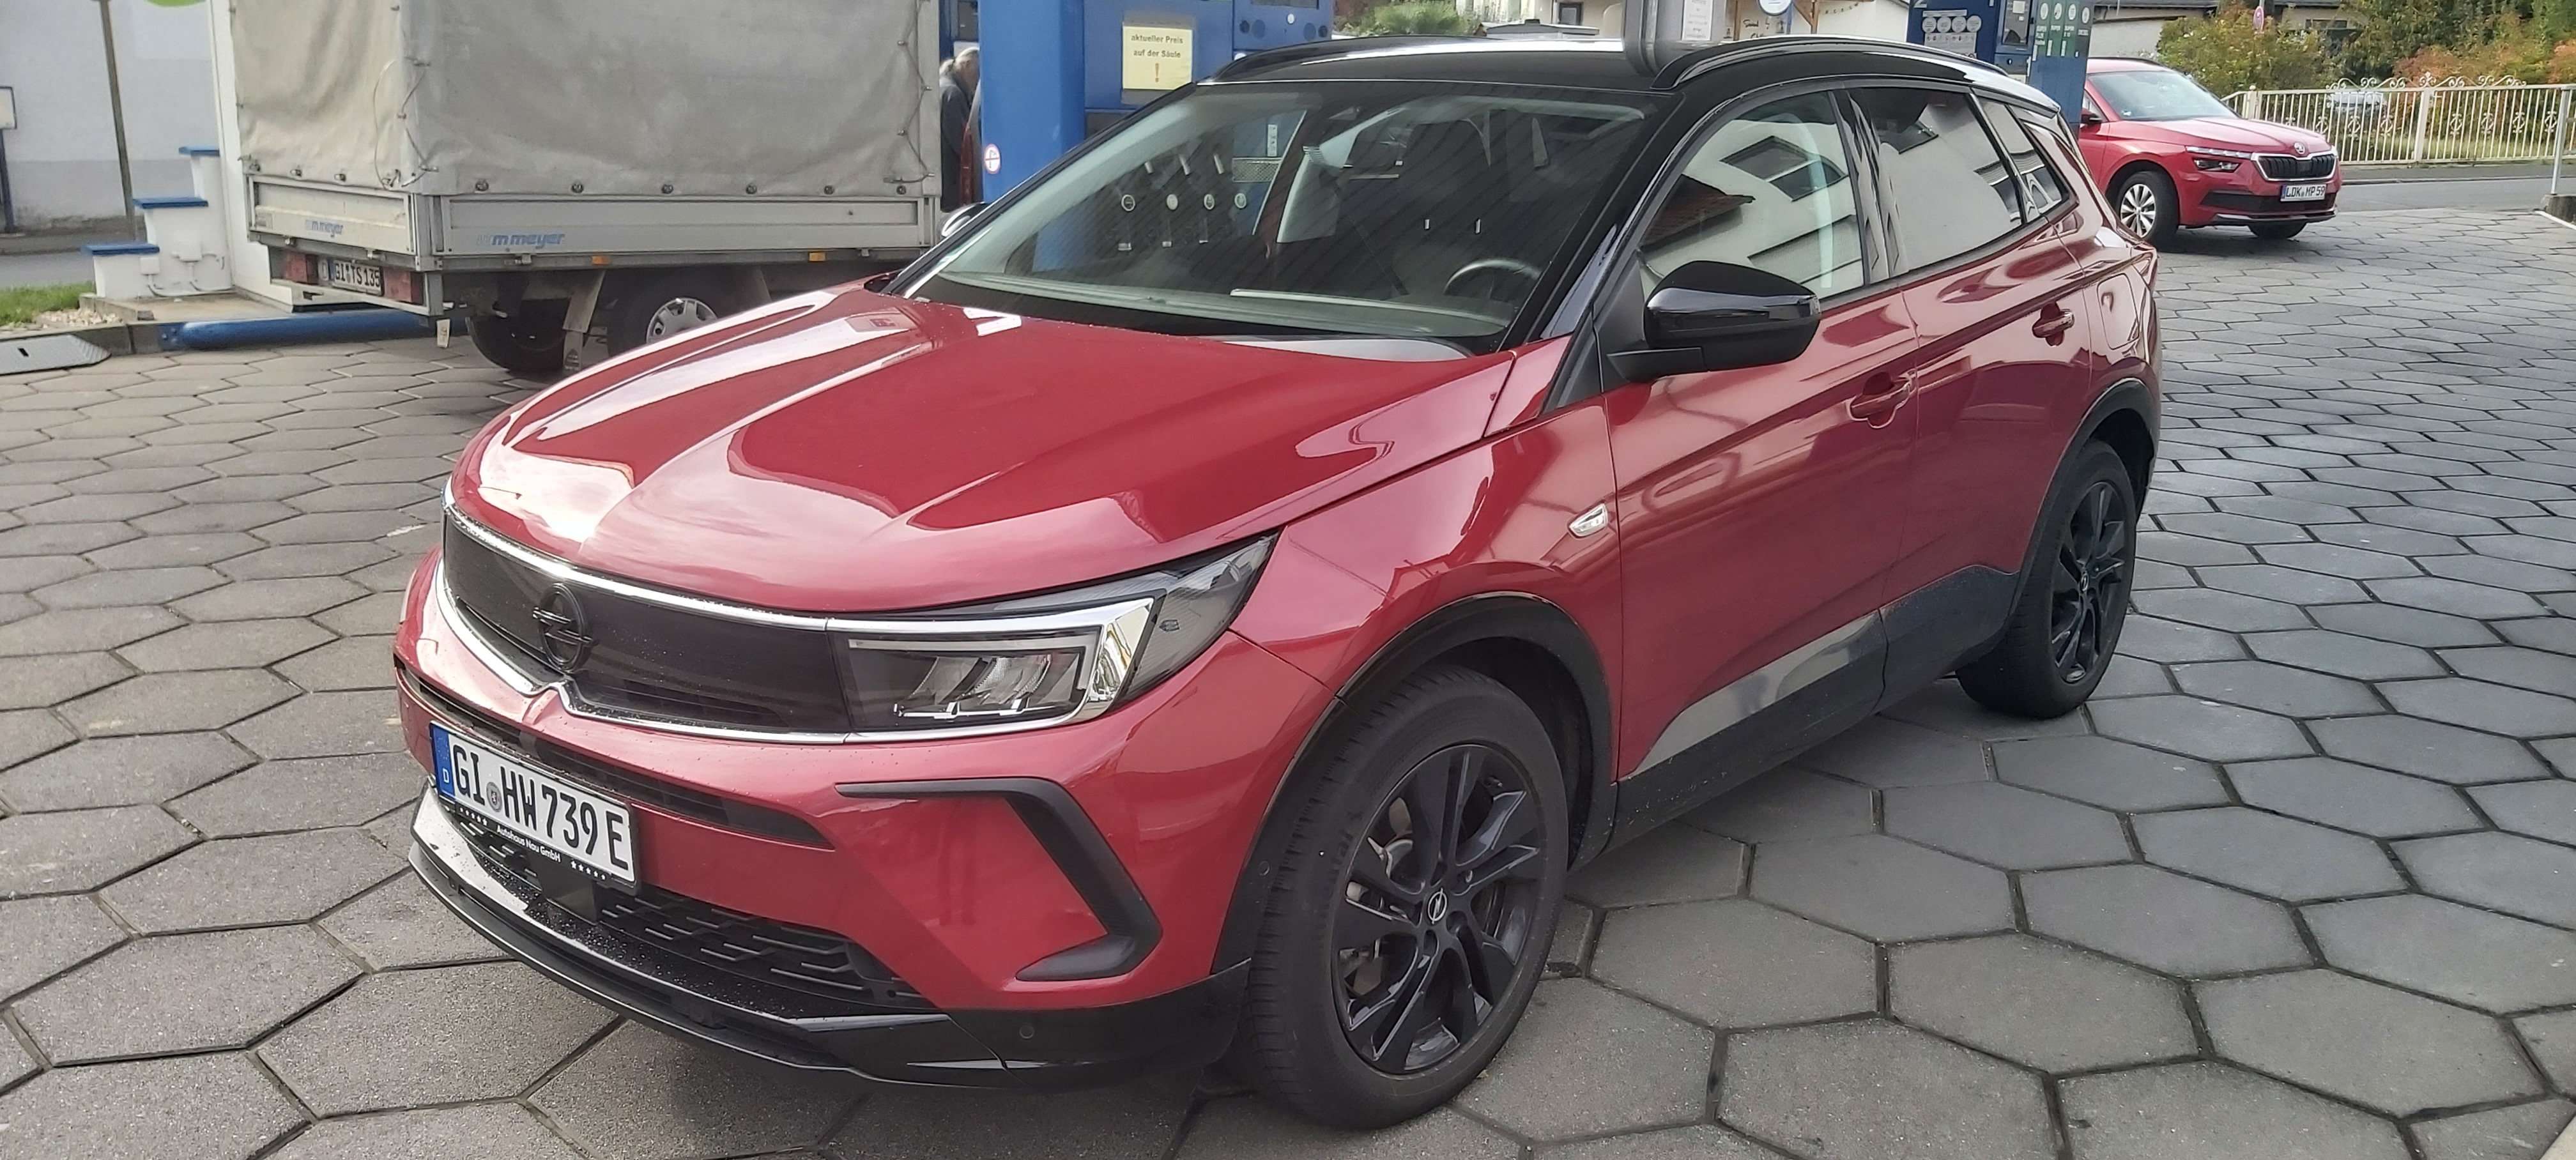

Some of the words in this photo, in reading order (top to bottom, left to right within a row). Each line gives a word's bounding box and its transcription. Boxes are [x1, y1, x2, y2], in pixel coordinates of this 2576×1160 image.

[1131, 34, 1163, 43] aktueller
[1165, 36, 1183, 44] Preis
[2287, 187, 2302, 197] LDK
[2315, 186, 2326, 195] 59
[510, 234, 565, 250] meyer
[335, 263, 346, 282] GI
[364, 268, 380, 287] 135
[443, 769, 450, 784] D
[453, 744, 486, 806] GI
[500, 766, 537, 831] HW
[541, 784, 599, 855] 739
[496, 824, 526, 846] Autohaus
[525, 838, 540, 853] Nau
[540, 845, 561, 863] GmbH
